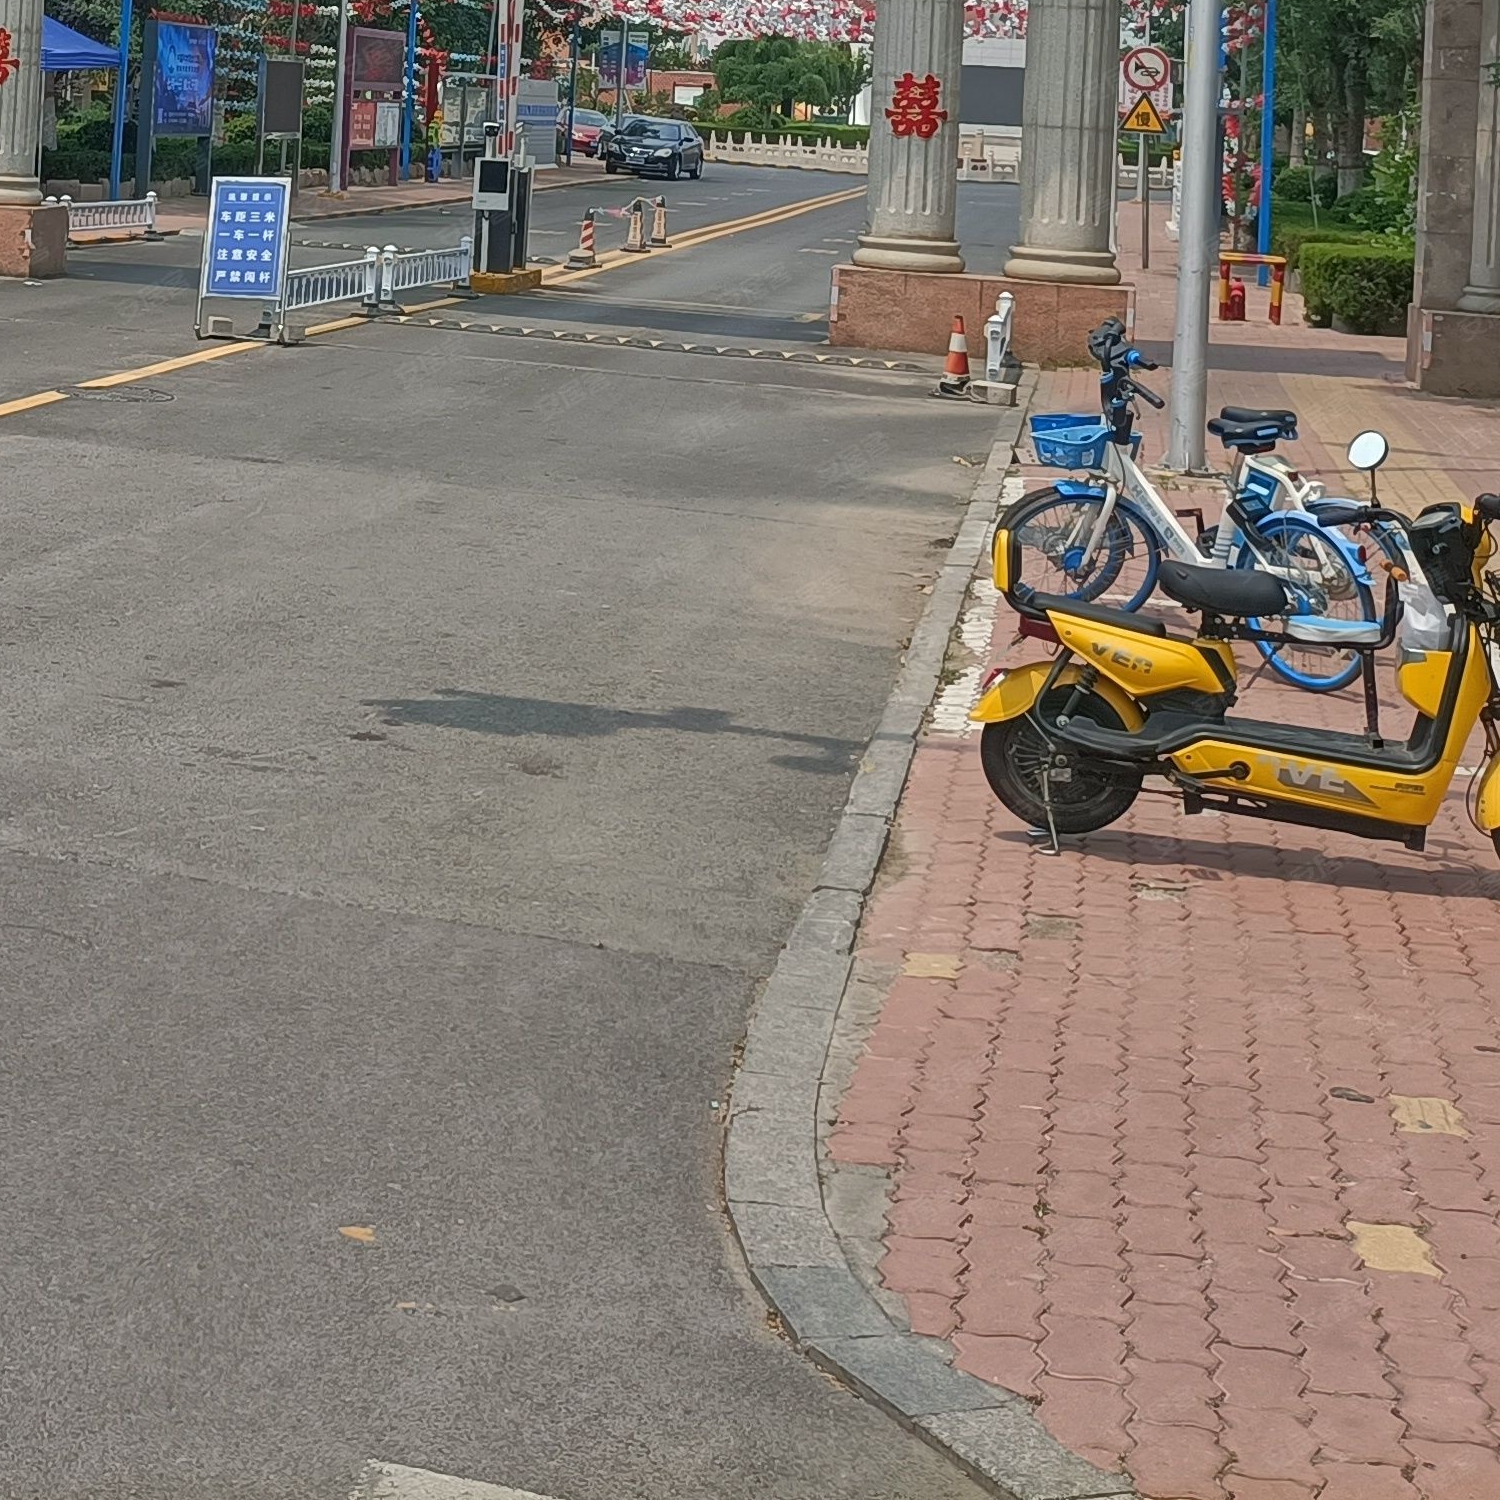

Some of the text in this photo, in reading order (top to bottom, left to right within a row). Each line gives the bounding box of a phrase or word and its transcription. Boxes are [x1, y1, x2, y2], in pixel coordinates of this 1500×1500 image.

[220, 210, 276, 222] 车距三米
[218, 229, 274, 241] 一车一杆
[216, 248, 273, 261] 注意安全
